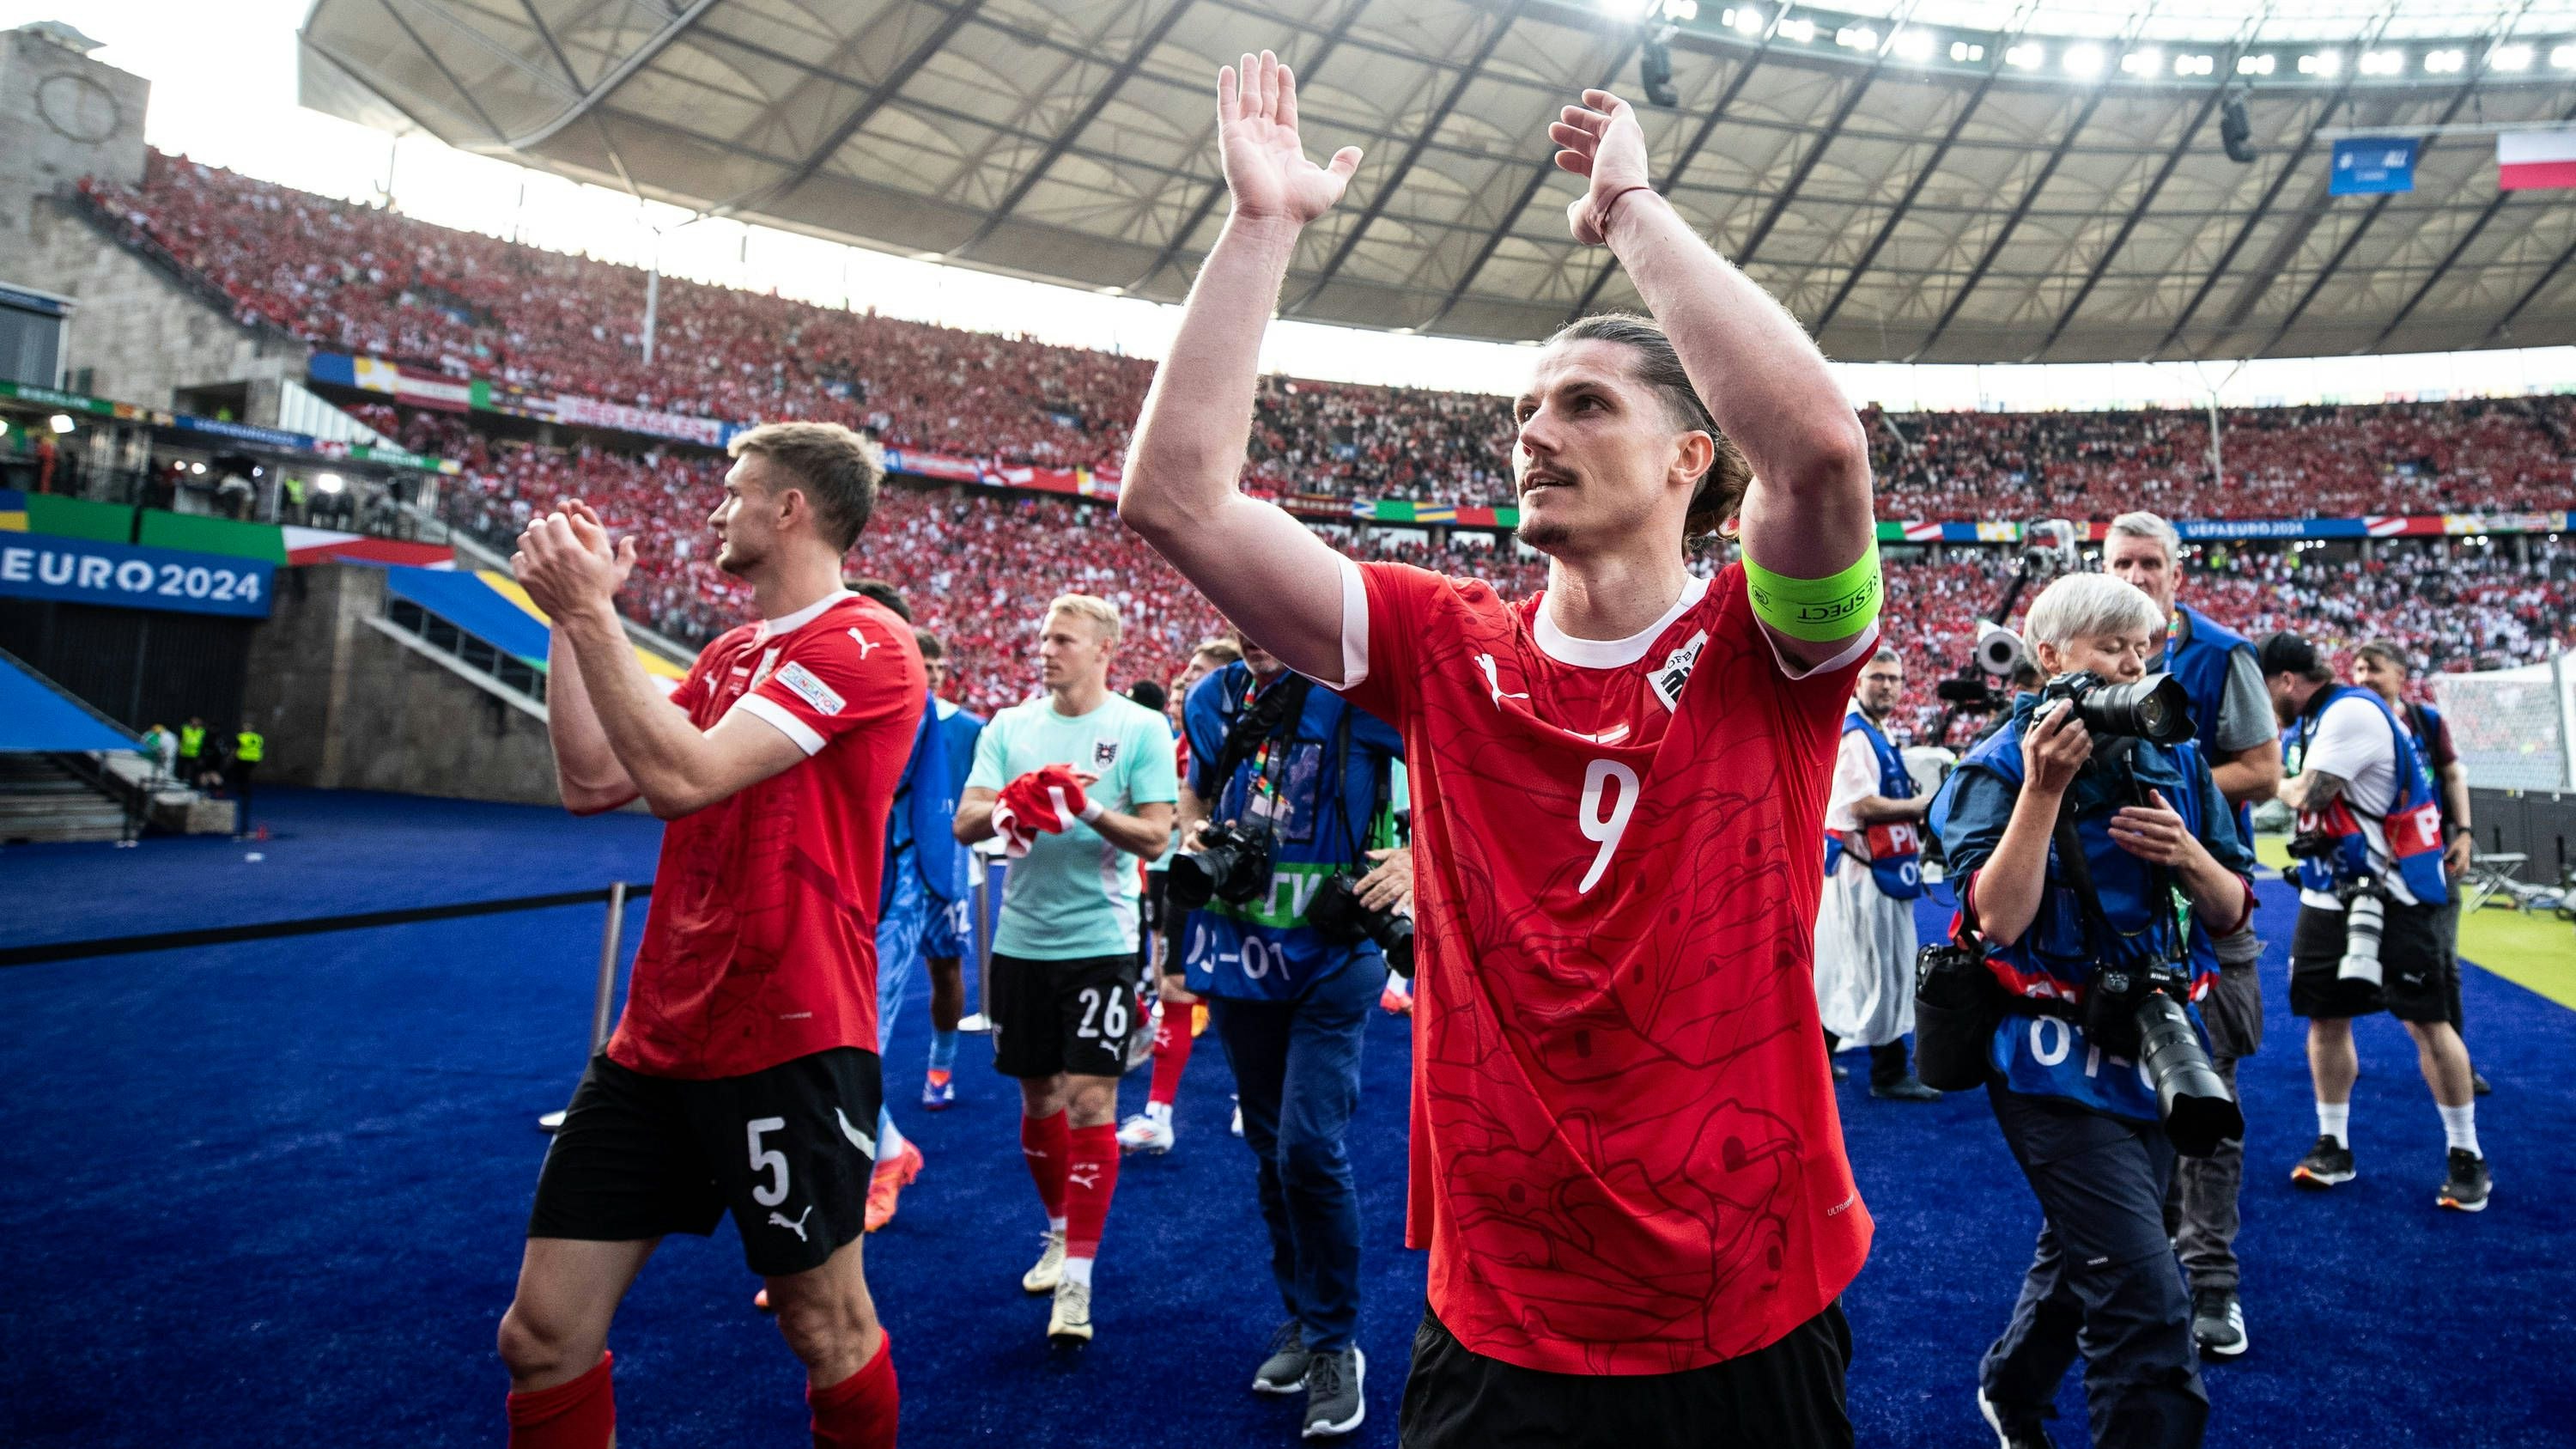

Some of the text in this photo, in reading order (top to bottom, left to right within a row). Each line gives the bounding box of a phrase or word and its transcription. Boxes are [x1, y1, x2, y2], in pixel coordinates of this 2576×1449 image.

[1, 546, 262, 603] EURO 2024
[1797, 568, 1878, 620] RESPECT
[1578, 758, 1640, 894] 9
[1264, 872, 1322, 918] TV
[2150, 972, 2170, 981] Nikon
[1077, 985, 1128, 1038] 26
[746, 1116, 790, 1207] 5
